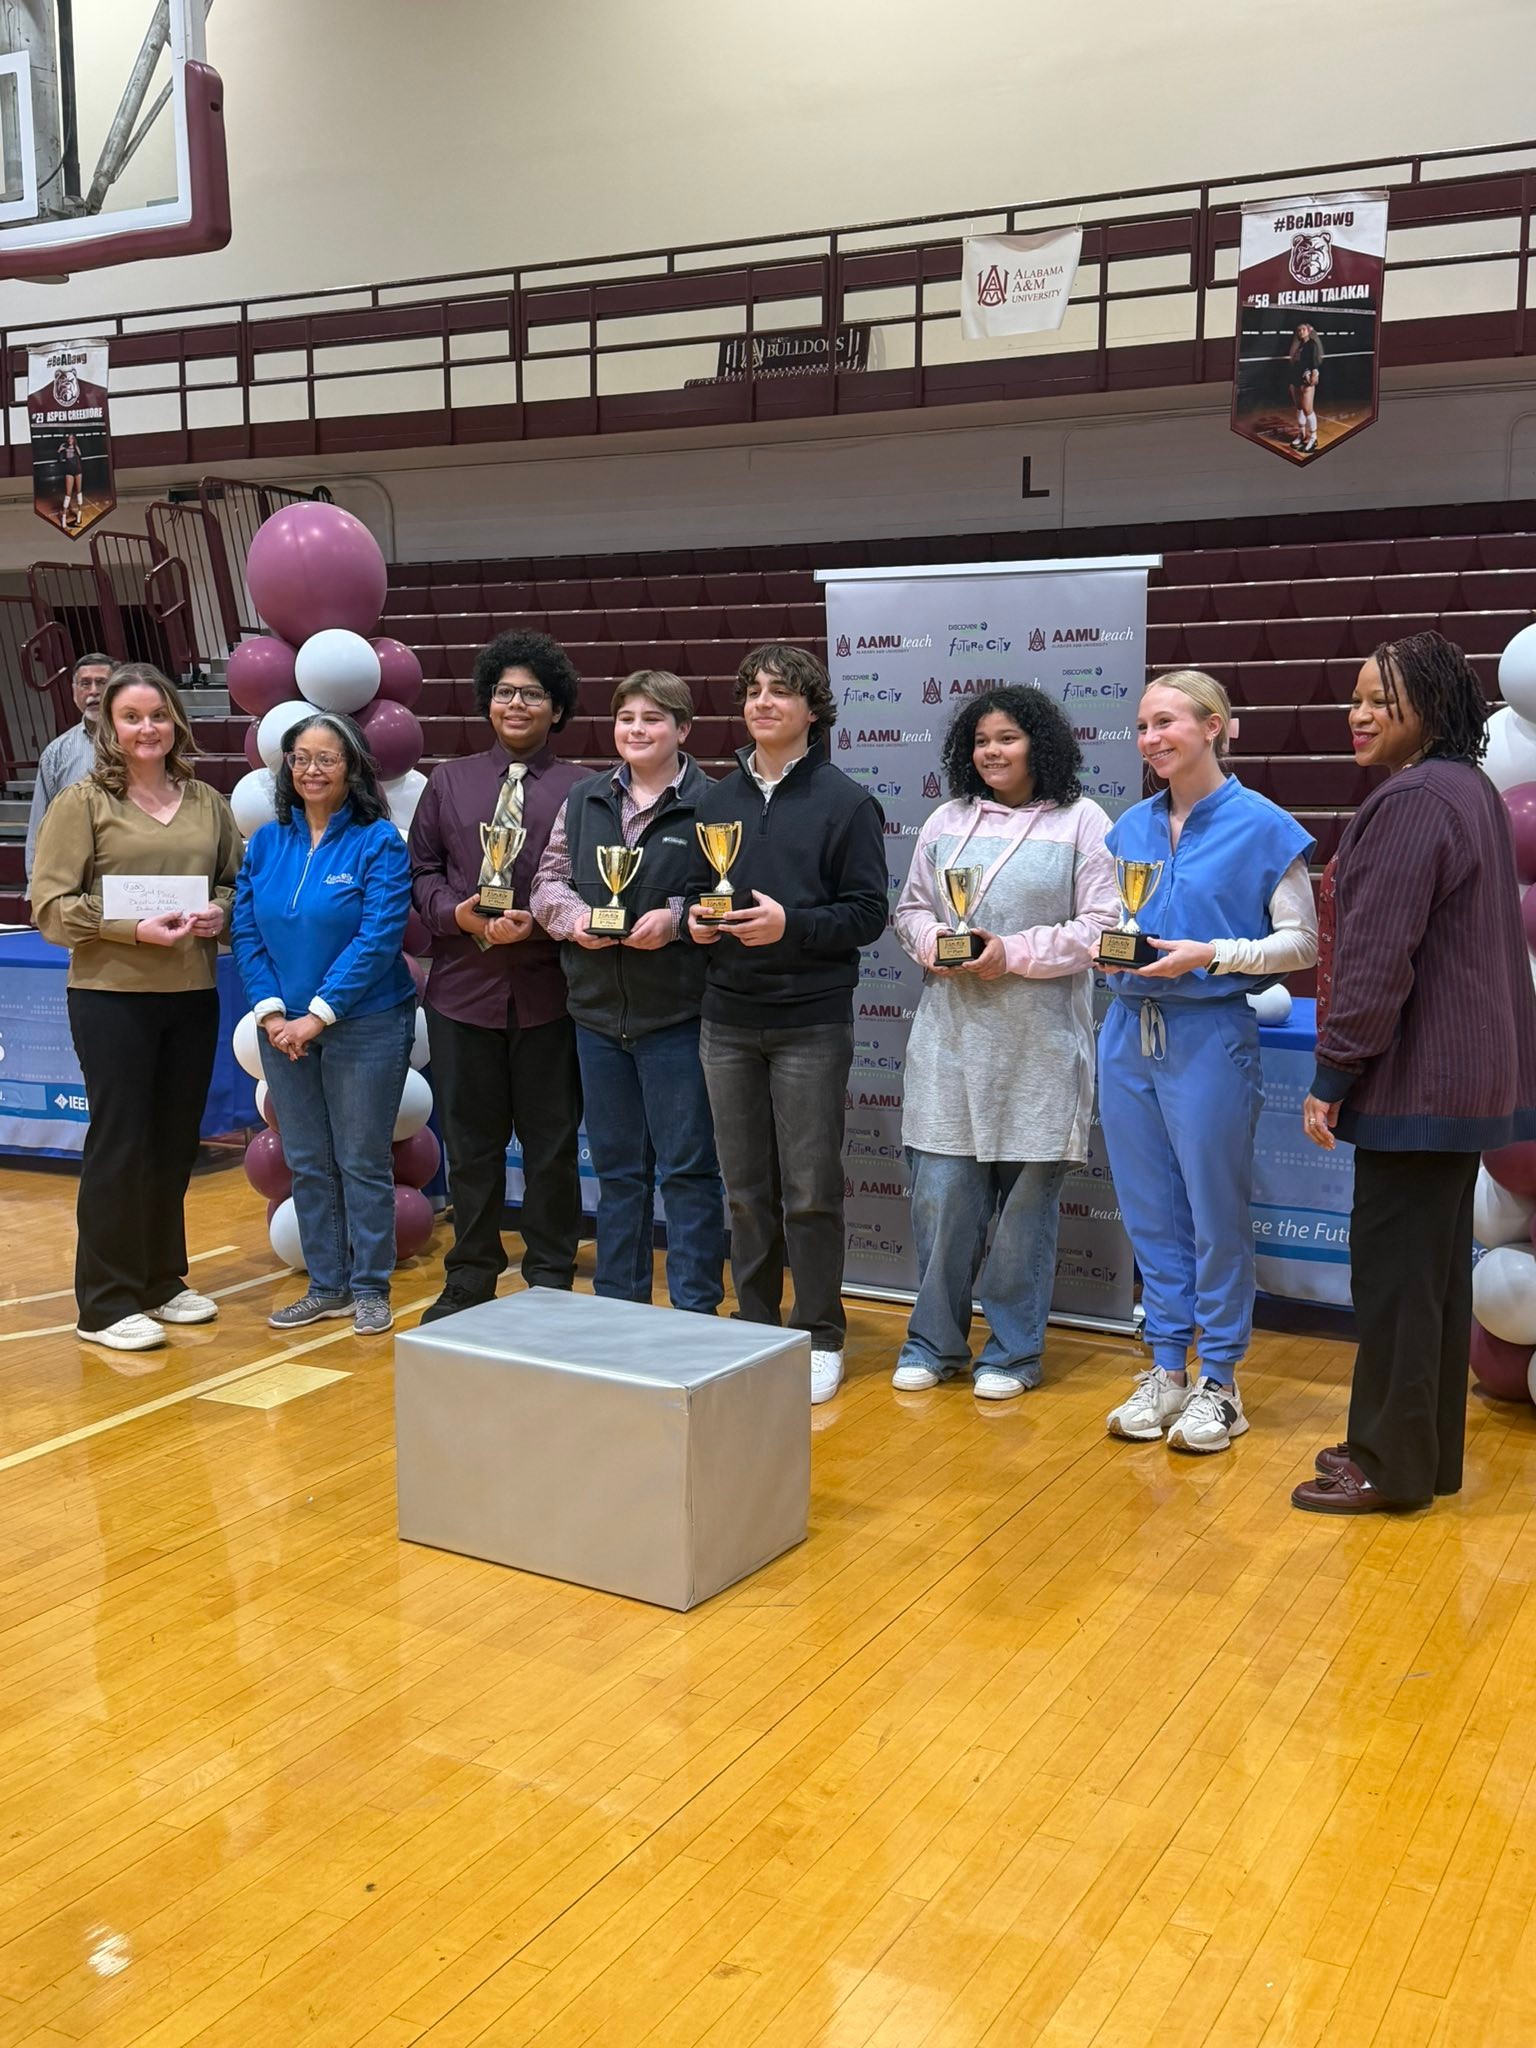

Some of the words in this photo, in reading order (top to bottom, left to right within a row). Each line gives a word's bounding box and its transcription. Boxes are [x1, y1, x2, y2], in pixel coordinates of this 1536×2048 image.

[1274, 211, 1354, 233] #BeADawg
[1013, 265, 1064, 280] ALABAMA
[1013, 278, 1046, 293] A&M
[1011, 289, 1062, 303] UNIVERSITY
[1248, 294, 1270, 308] #58
[1277, 289, 1319, 306] KELANI
[1321, 284, 1370, 302] TALAKAI
[47, 410, 68, 422] ASPEN
[1022, 456, 1050, 498] L
[1252, 1220, 1273, 1235] ee
[1278, 1219, 1310, 1239] the
